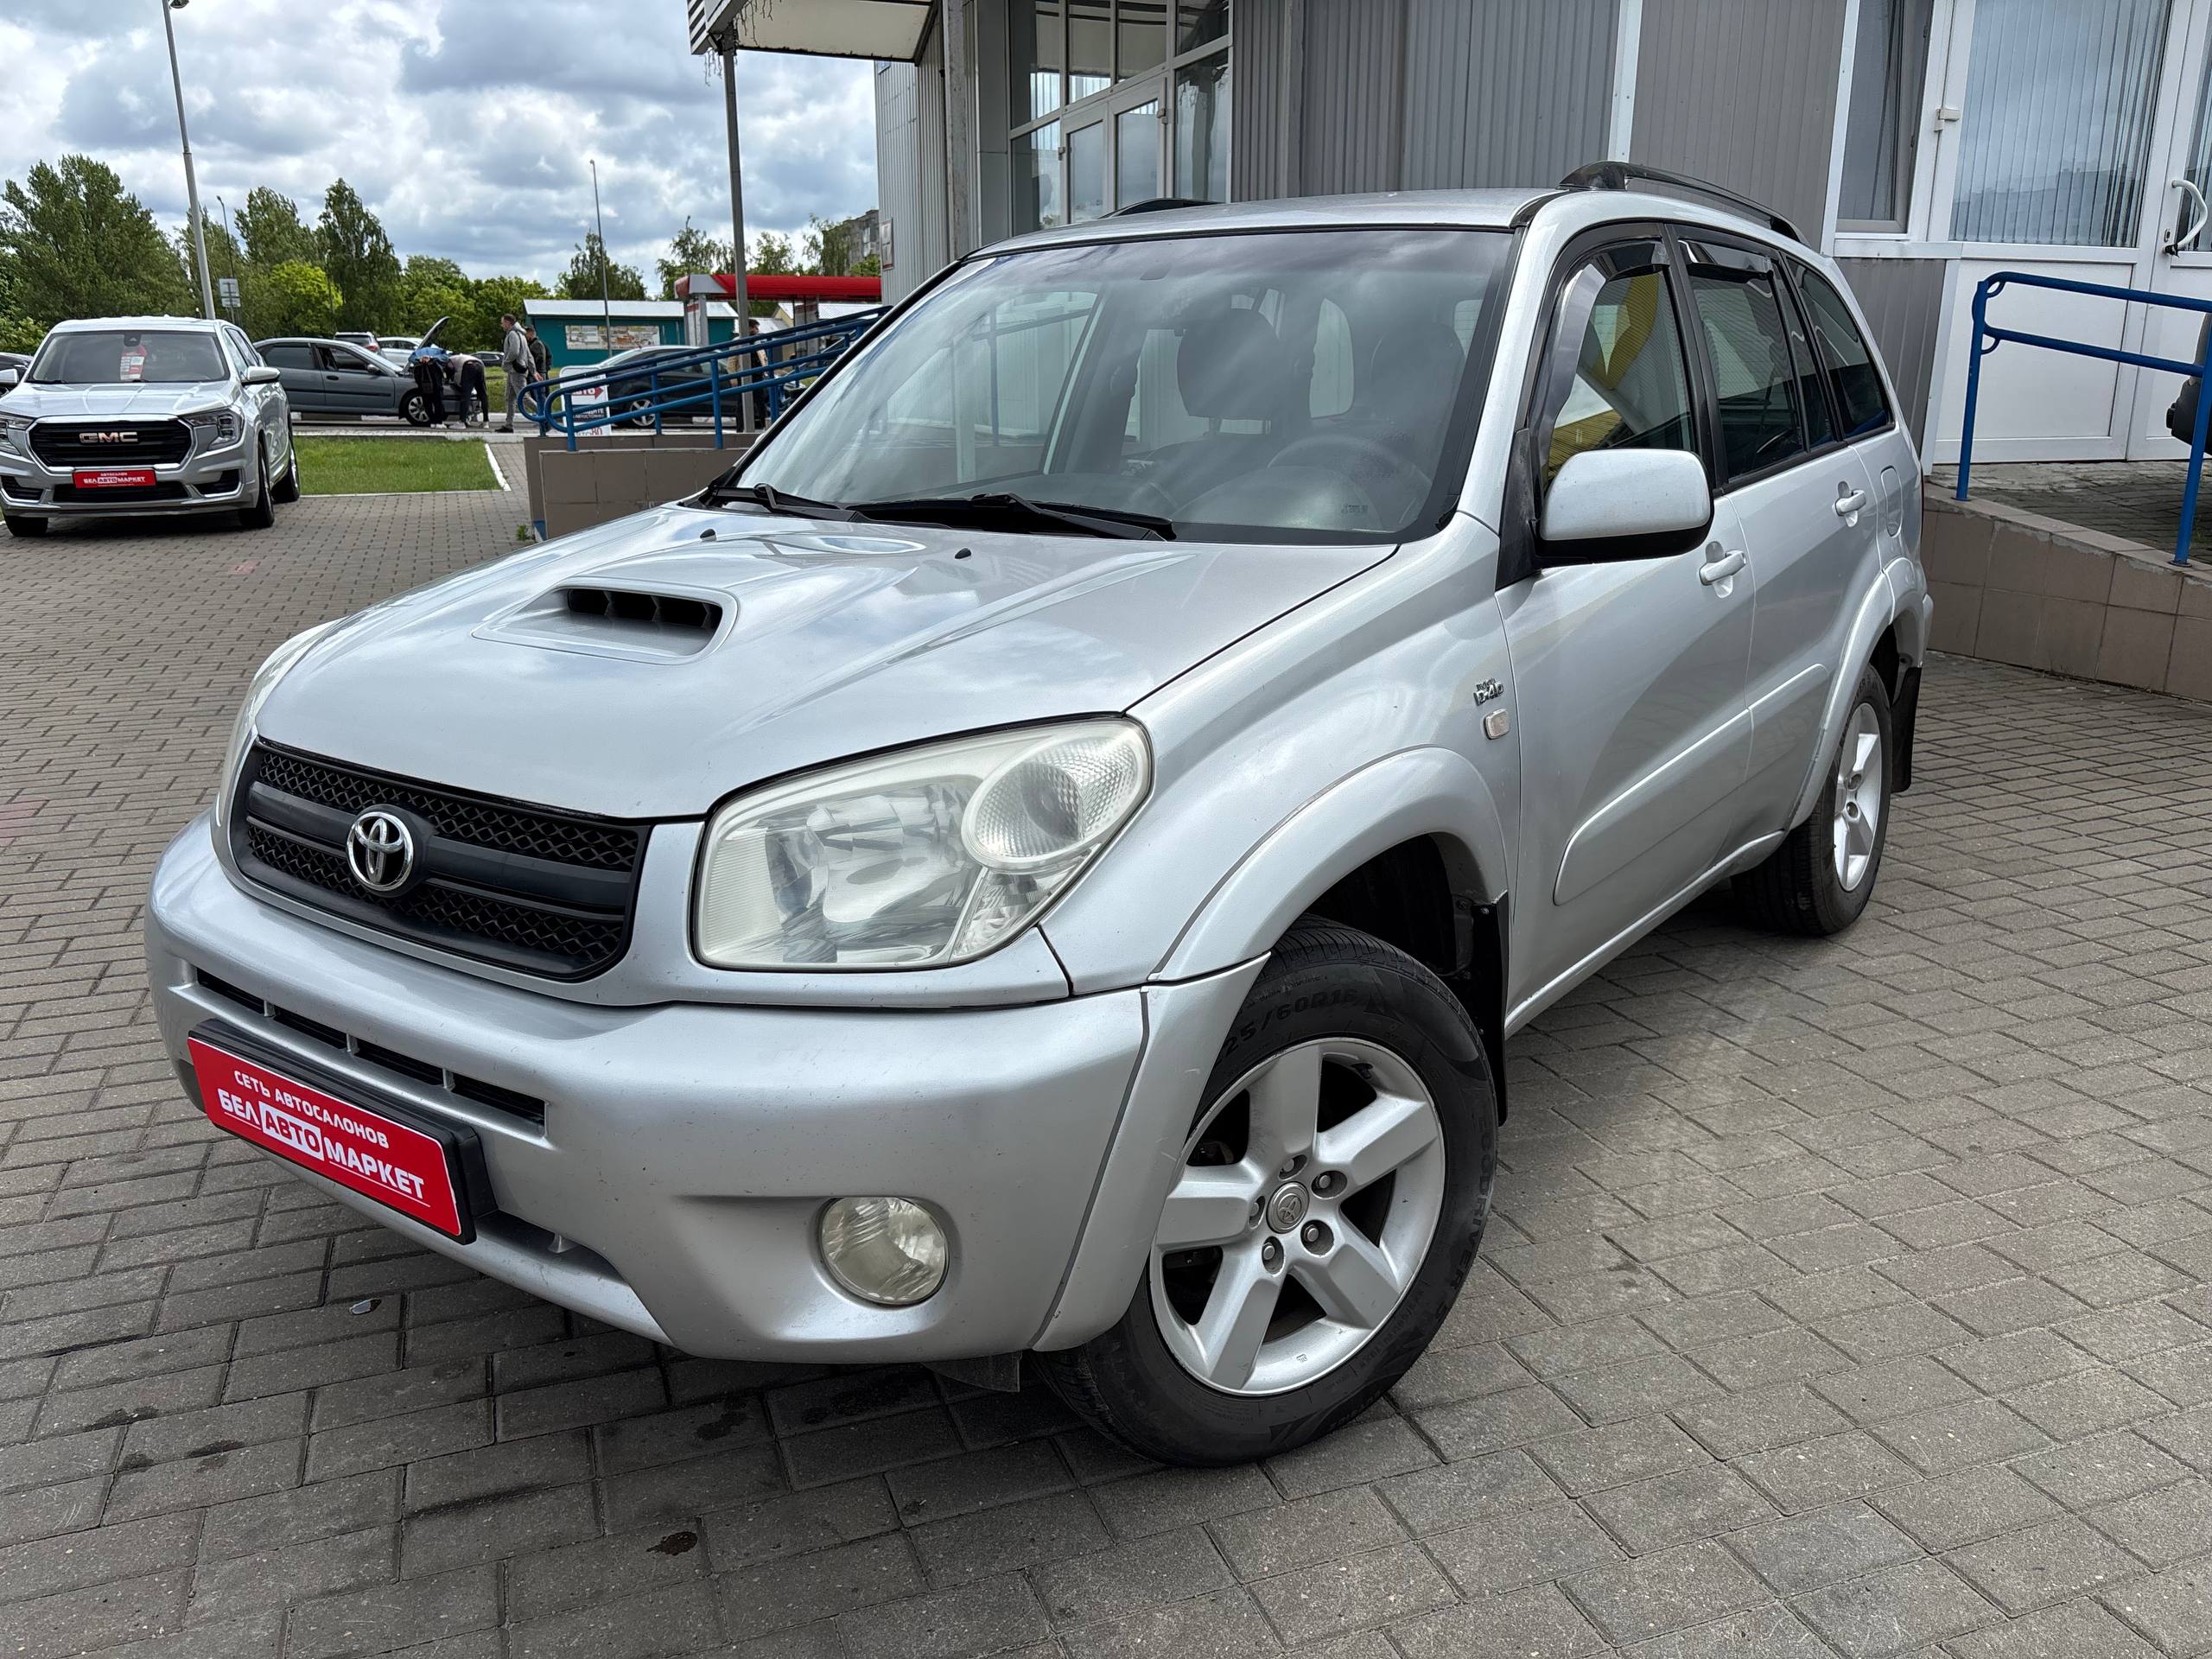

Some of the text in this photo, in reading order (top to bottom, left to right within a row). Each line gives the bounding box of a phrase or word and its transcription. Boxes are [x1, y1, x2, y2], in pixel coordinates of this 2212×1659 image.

[79, 432, 138, 443] GMC
[1216, 988, 1360, 1066] 25/60R16
[233, 1070, 390, 1149] СЕТЬ АВТОСАЛОНОВ
